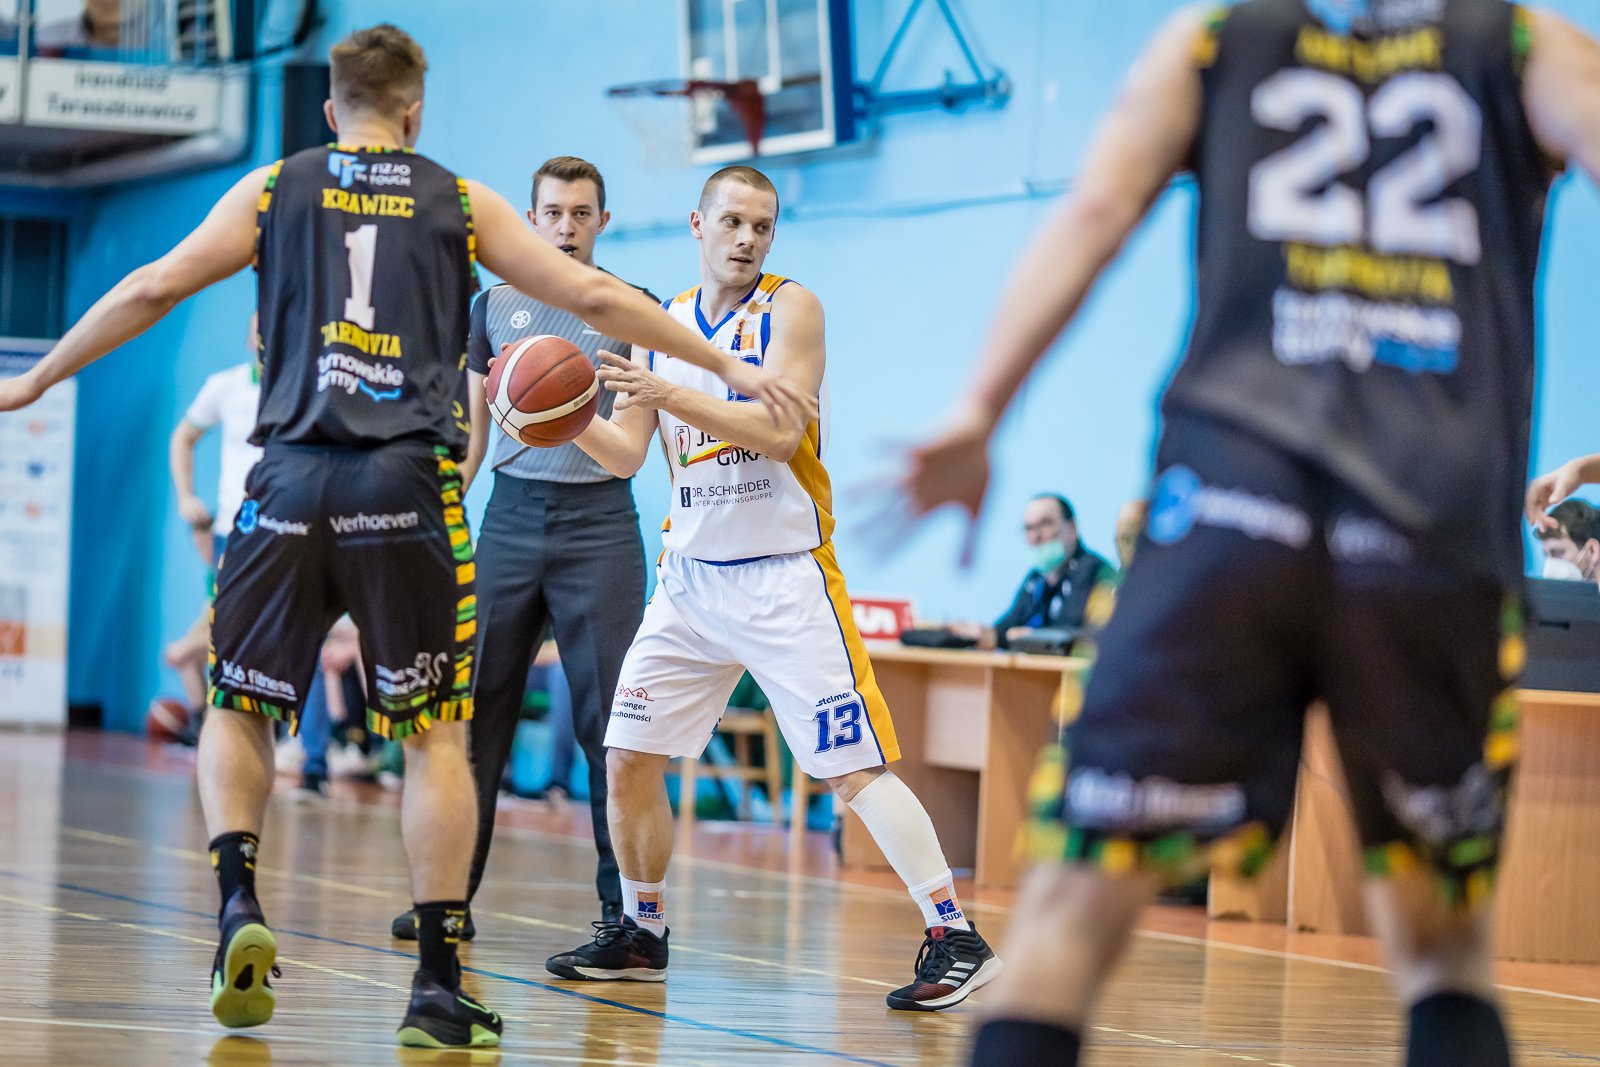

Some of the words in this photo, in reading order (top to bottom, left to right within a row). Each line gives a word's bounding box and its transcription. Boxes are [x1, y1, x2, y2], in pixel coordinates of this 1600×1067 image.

[1248, 67, 1483, 266] 22
[322, 188, 415, 218] KRAWIEC
[345, 224, 378, 331] 1
[692, 487, 706, 498] DR.
[708, 478, 772, 497] SCHNEIDER
[329, 511, 419, 534] Verhoeven
[812, 700, 862, 753] 13
